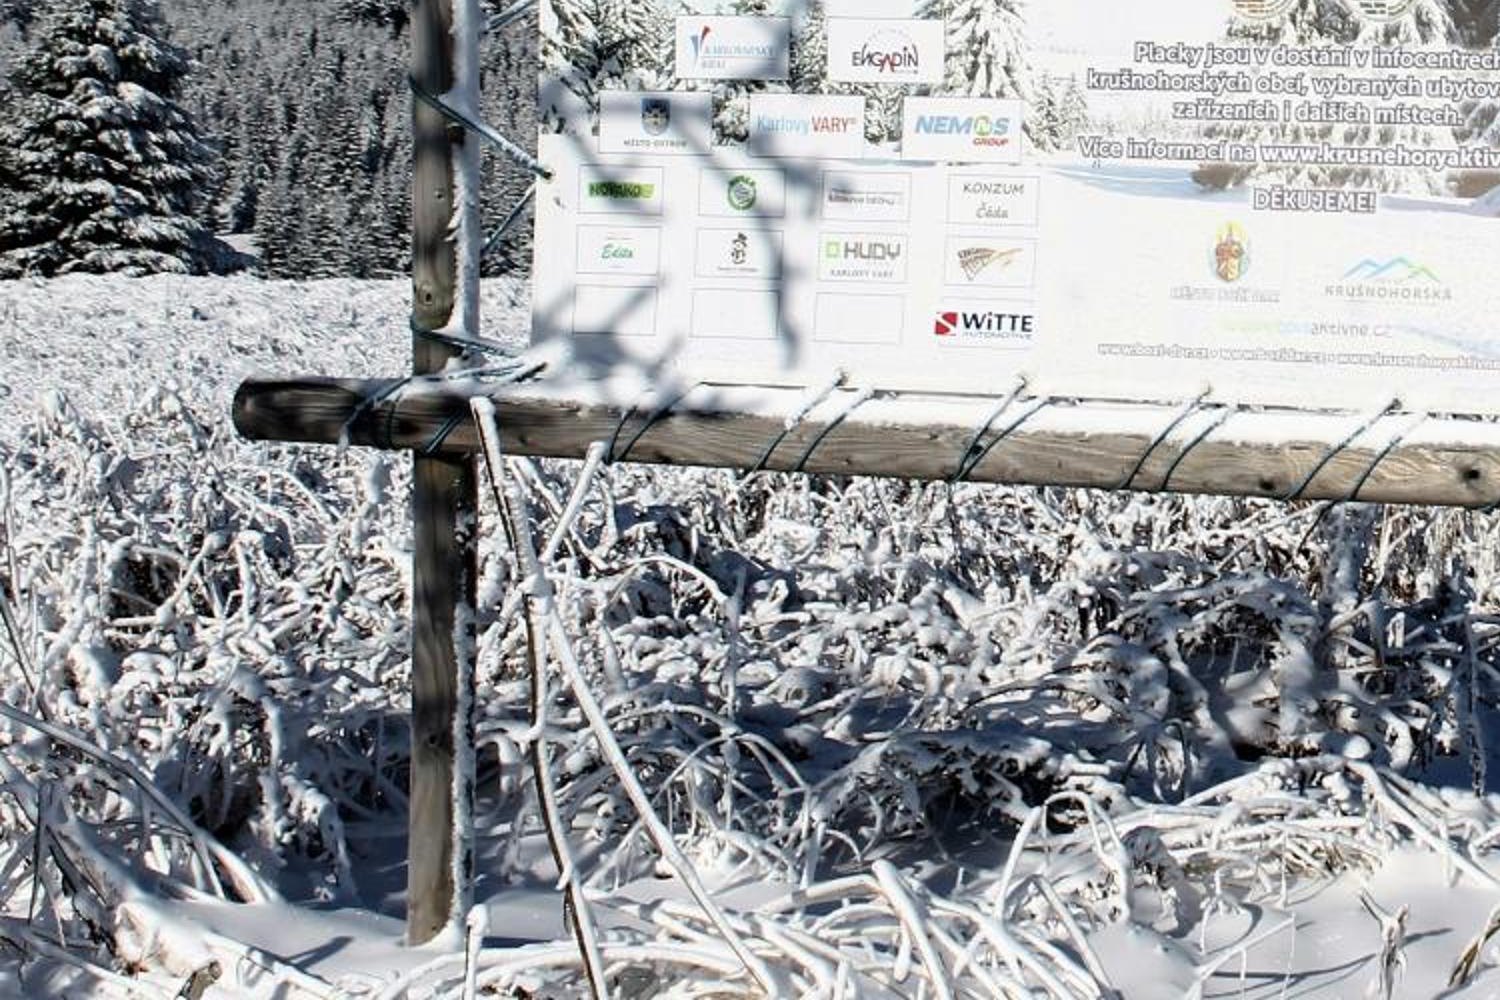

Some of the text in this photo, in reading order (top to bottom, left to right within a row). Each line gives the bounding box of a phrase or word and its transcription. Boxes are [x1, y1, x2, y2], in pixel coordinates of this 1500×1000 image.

[1134, 41, 1201, 67] Placky
[1203, 43, 1250, 68] jsou
[1253, 49, 1269, 65] v
[1272, 44, 1349, 67] dostání
[1351, 50, 1370, 68] v
[1087, 68, 1251, 95] krušnohorských
[1255, 72, 1309, 96] obcí,
[1311, 74, 1423, 100] vybraných
[1172, 98, 1465, 126] zařízeních i dalších místech.
[1077, 135, 1124, 158] Více
[1126, 138, 1228, 161] informací
[1229, 144, 1257, 162] na
[963, 182, 1025, 196] KONZUM
[1251, 184, 1378, 214] DĚKUJEME!
[844, 242, 901, 260] HUDY
